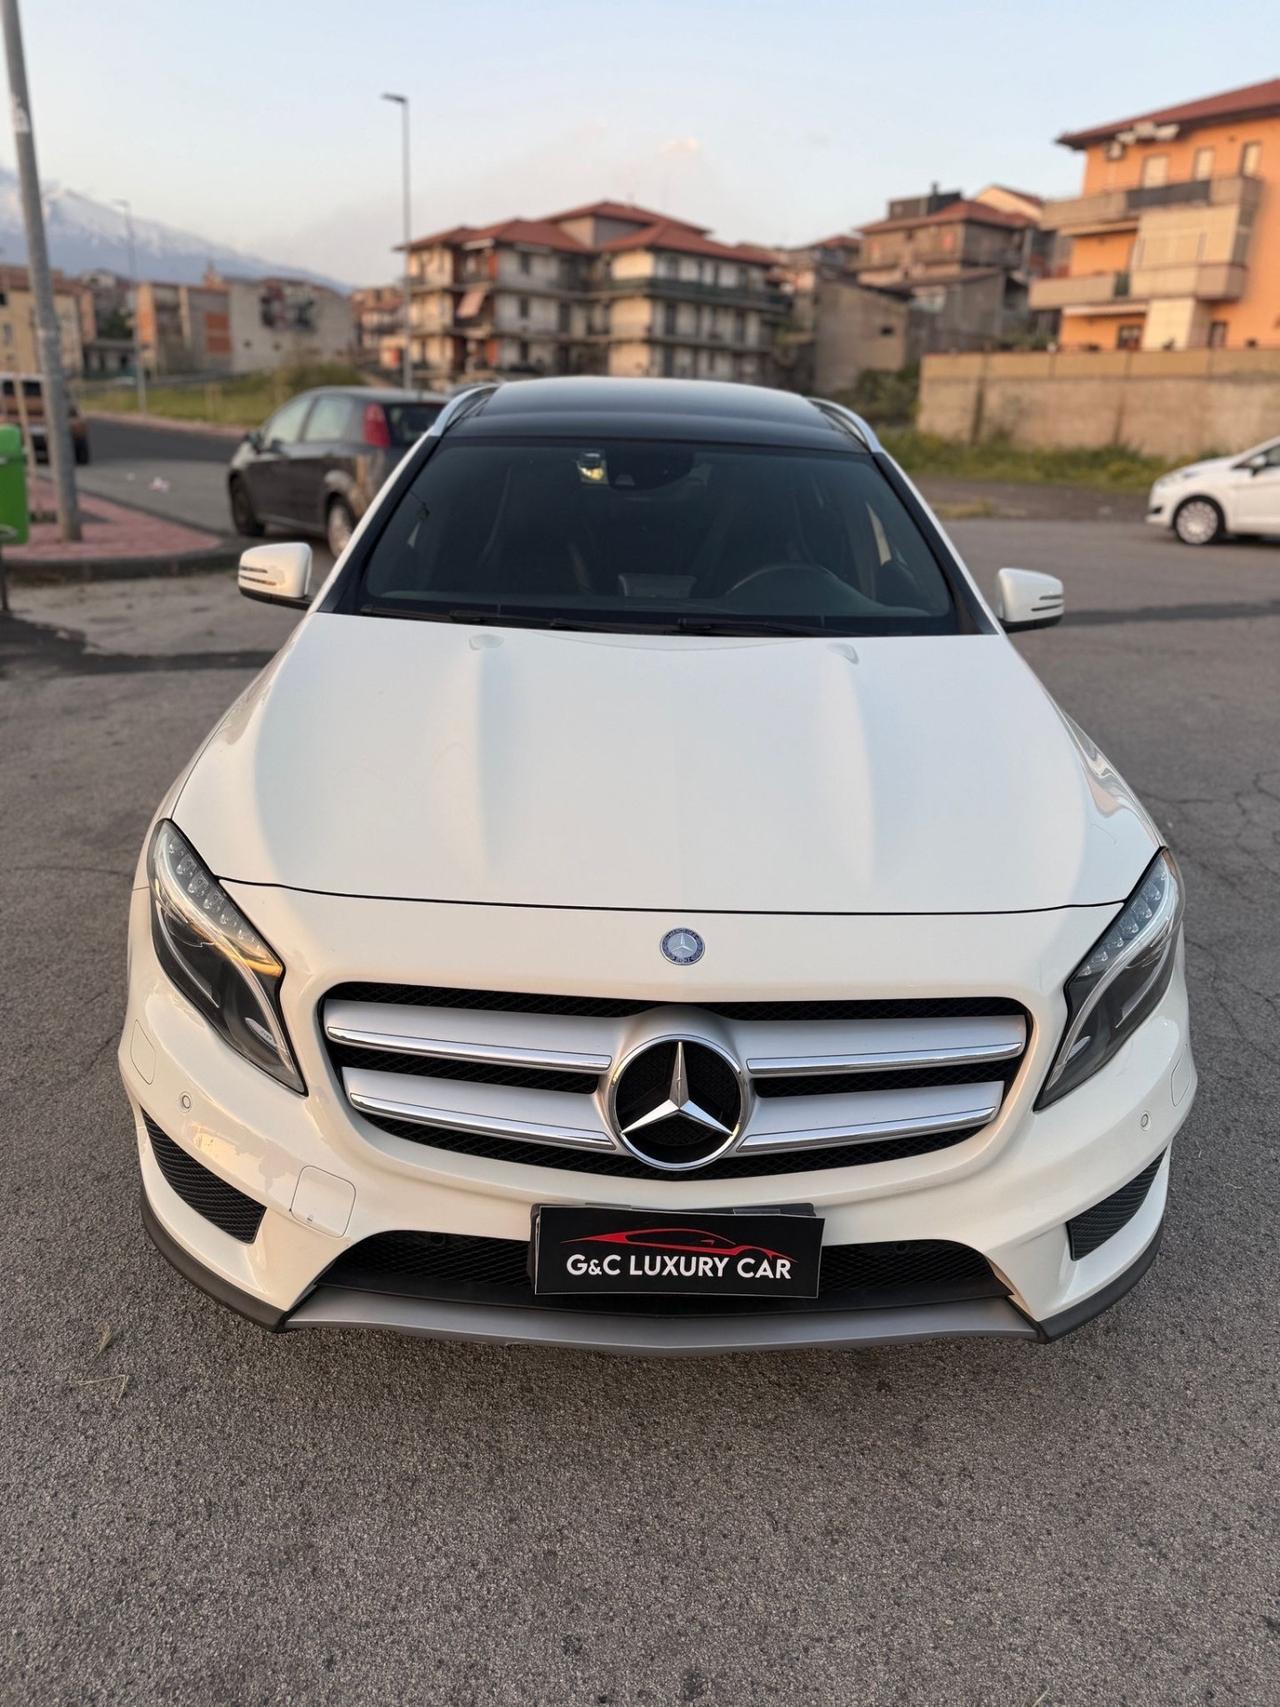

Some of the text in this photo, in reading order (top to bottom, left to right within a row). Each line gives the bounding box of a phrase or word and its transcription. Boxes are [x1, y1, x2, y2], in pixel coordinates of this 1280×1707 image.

[566, 1253, 792, 1280] G&C LUXURY CAR
